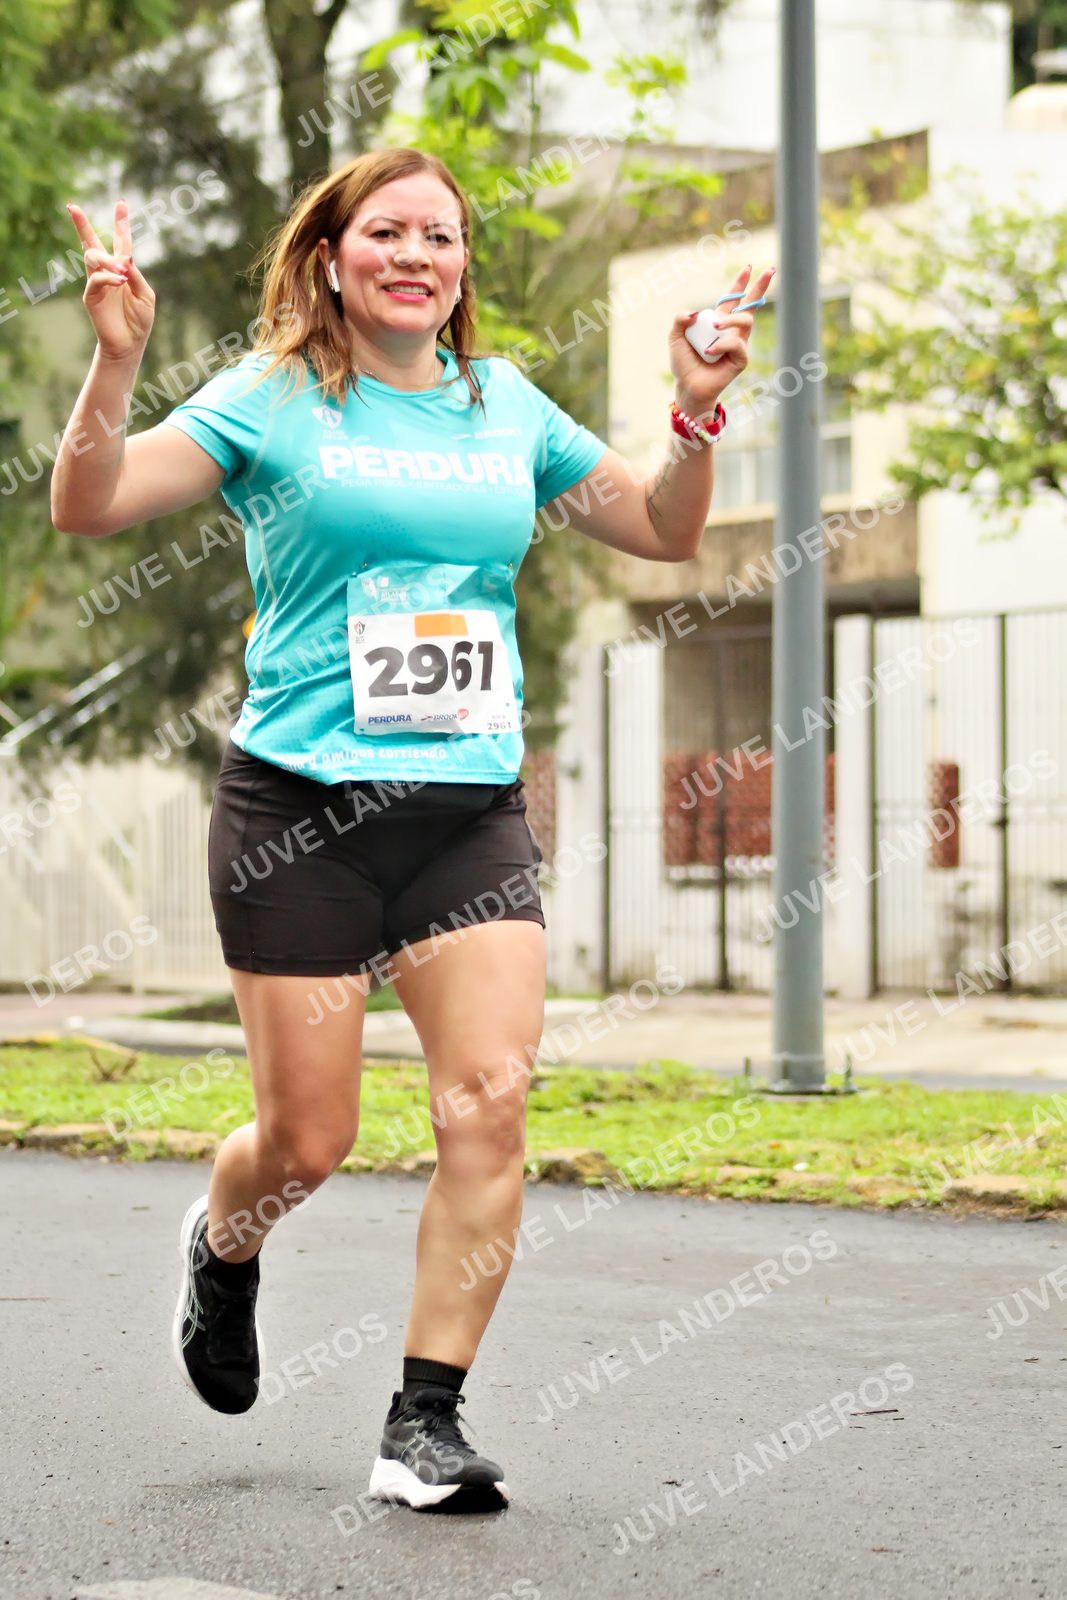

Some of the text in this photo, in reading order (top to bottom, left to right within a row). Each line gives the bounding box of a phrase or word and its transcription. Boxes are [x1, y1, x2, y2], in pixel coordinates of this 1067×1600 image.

[318, 445, 533, 489] PERDURA
[364, 641, 494, 698] 2961
[368, 714, 413, 725] PERDURA
[487, 722, 512, 731] 2961
[378, 747, 447, 760] corriendo
